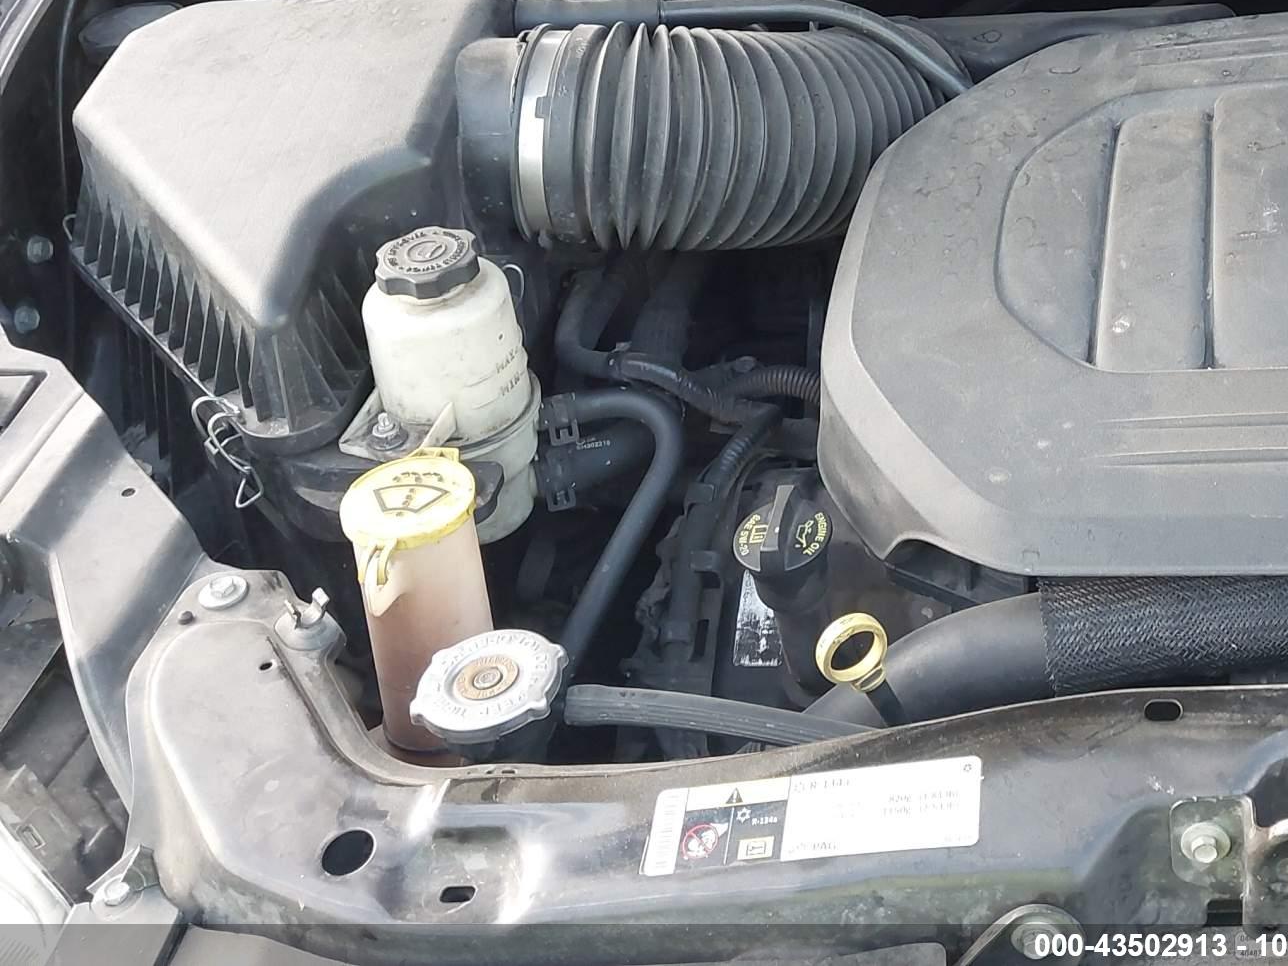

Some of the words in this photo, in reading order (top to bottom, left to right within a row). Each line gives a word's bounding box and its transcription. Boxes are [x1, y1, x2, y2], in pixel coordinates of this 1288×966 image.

[496, 347, 516, 374] MAX
[500, 371, 521, 397] MIN
[743, 513, 761, 534] SAE
[814, 511, 828, 543] ENGINE
[738, 530, 750, 556] 5W-20
[802, 541, 820, 557] OIL
